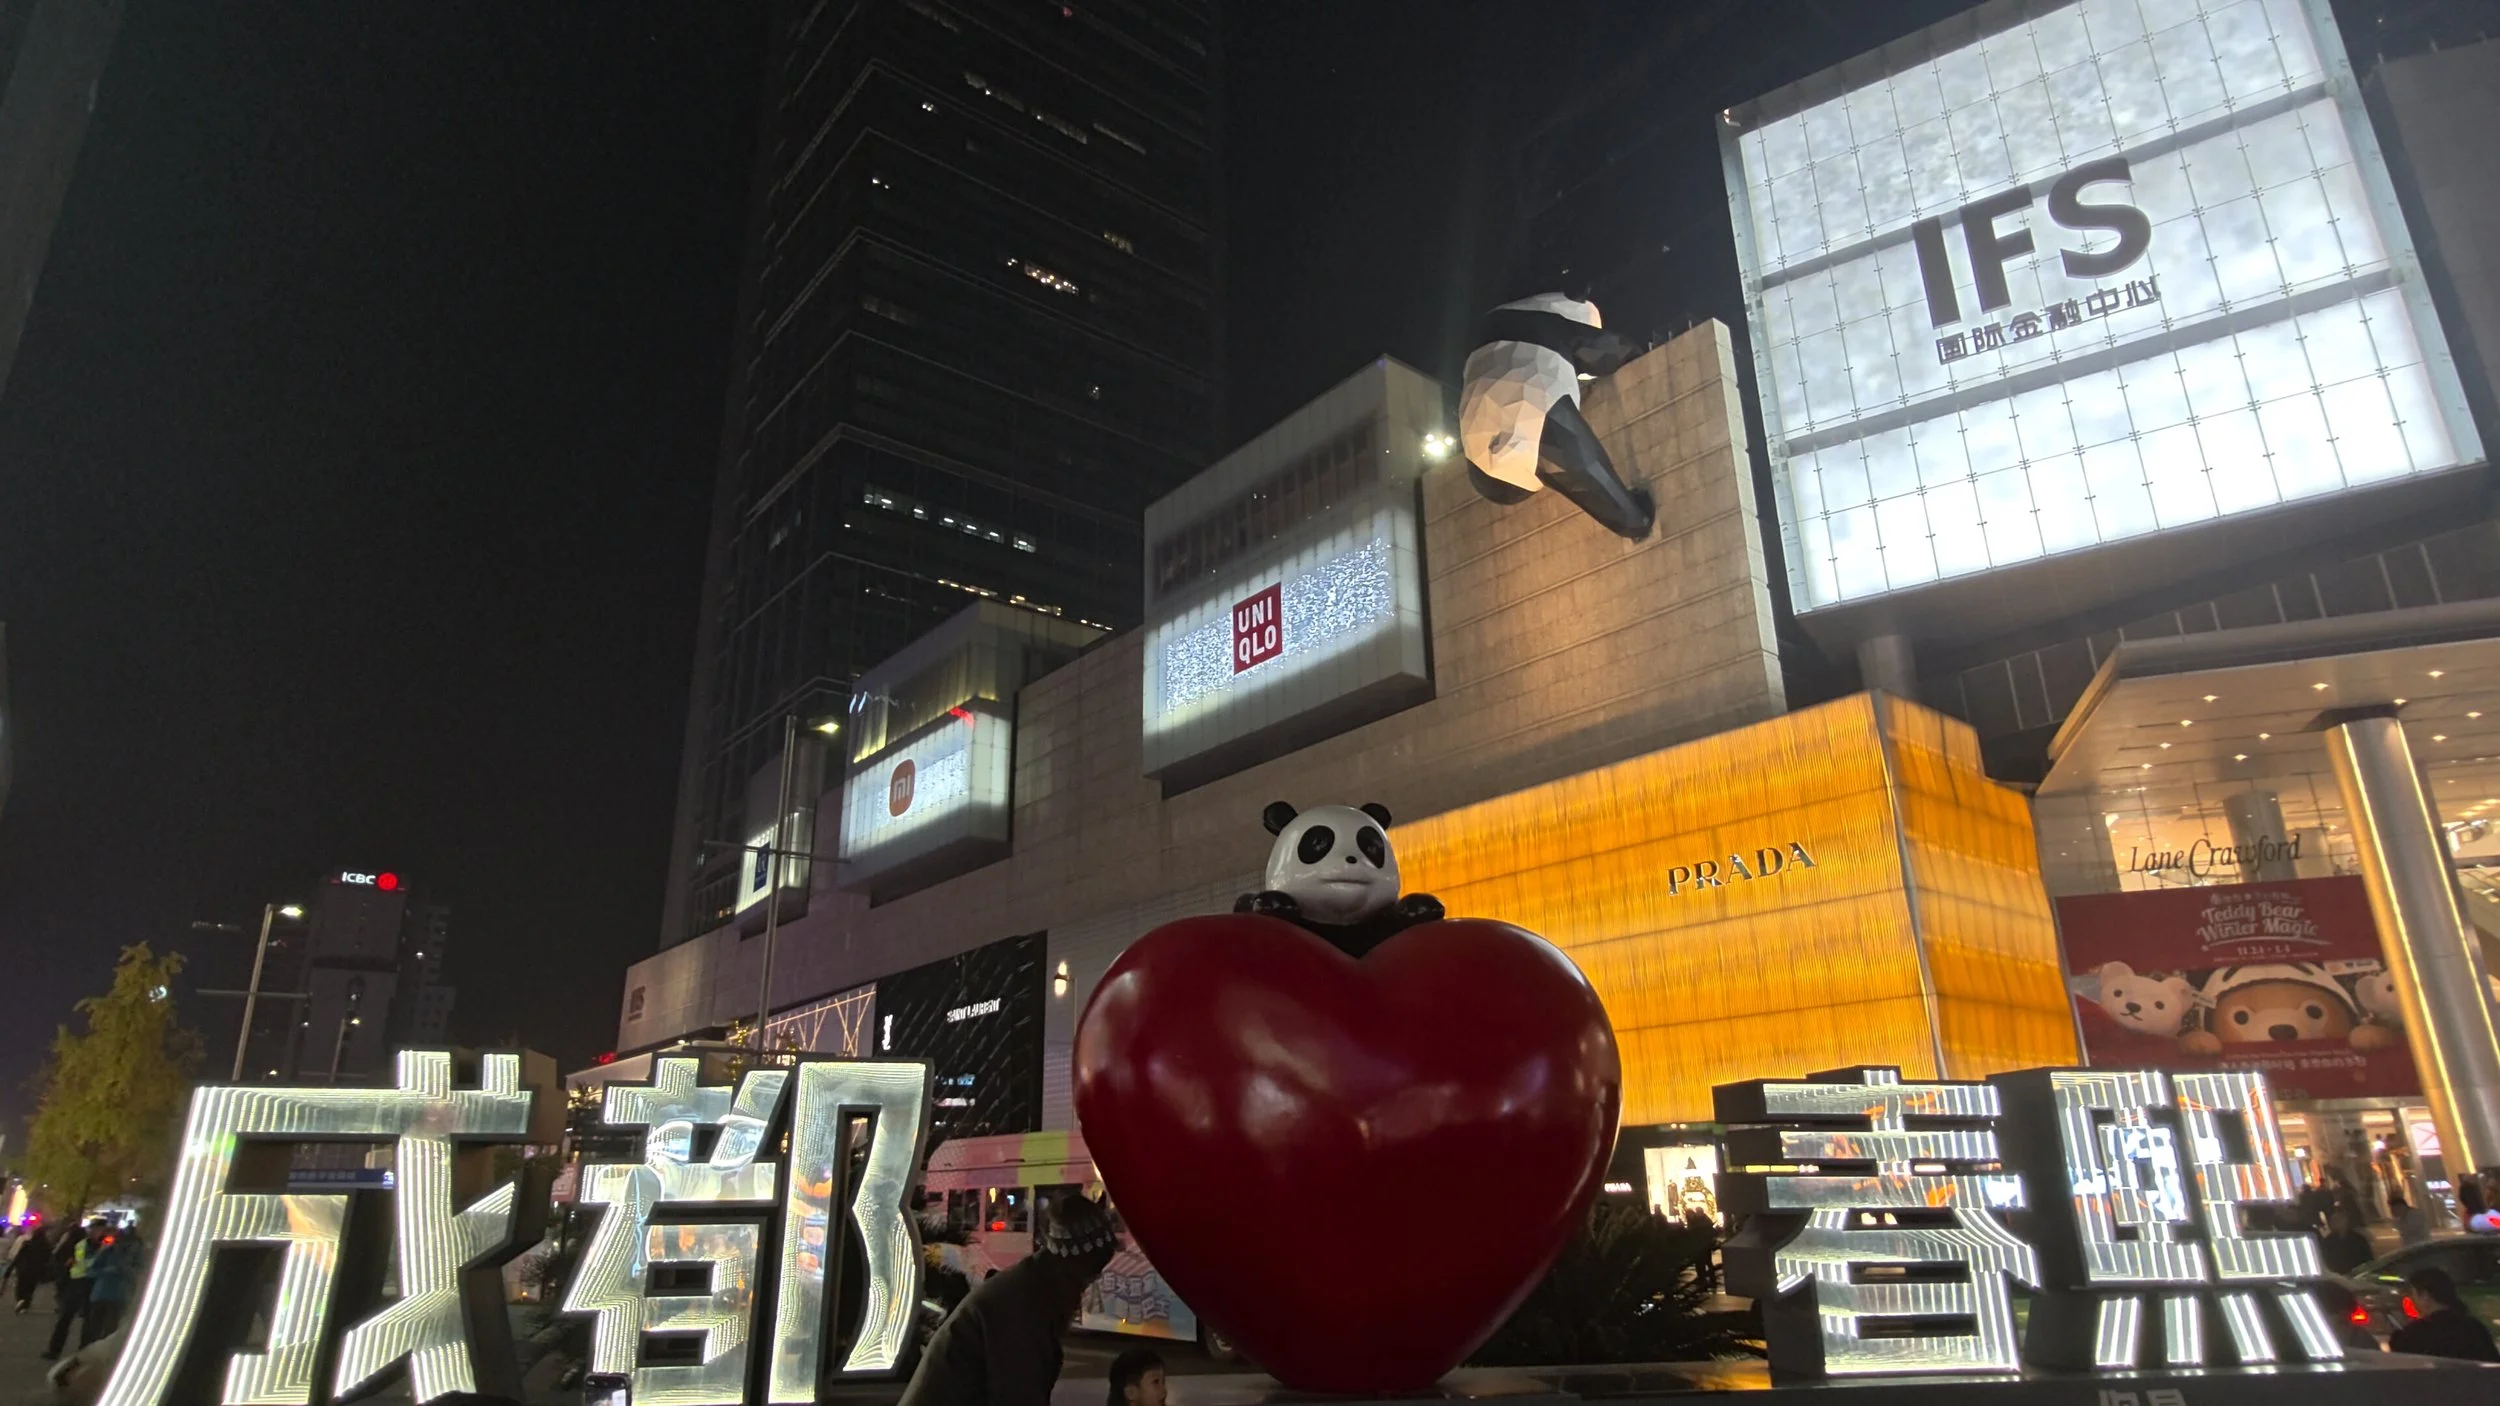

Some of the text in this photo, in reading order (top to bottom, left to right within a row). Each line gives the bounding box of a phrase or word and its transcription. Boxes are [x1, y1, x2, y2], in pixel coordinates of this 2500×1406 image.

[1911, 157, 2152, 330] IFS
[1936, 275, 2162, 366] 国际金融中心
[1238, 596, 1273, 633] UNI
[1239, 625, 1277, 664] QLO
[1667, 841, 1817, 896] PRADA
[2129, 832, 2302, 877] Lane Crawford
[341, 871, 376, 885] ICBC
[2195, 917, 2320, 943] Winter Magic
[2200, 900, 2305, 924] Teddy Bear
[95, 1049, 930, 1406] 成都
[1755, 1066, 2345, 1377] 春熙
